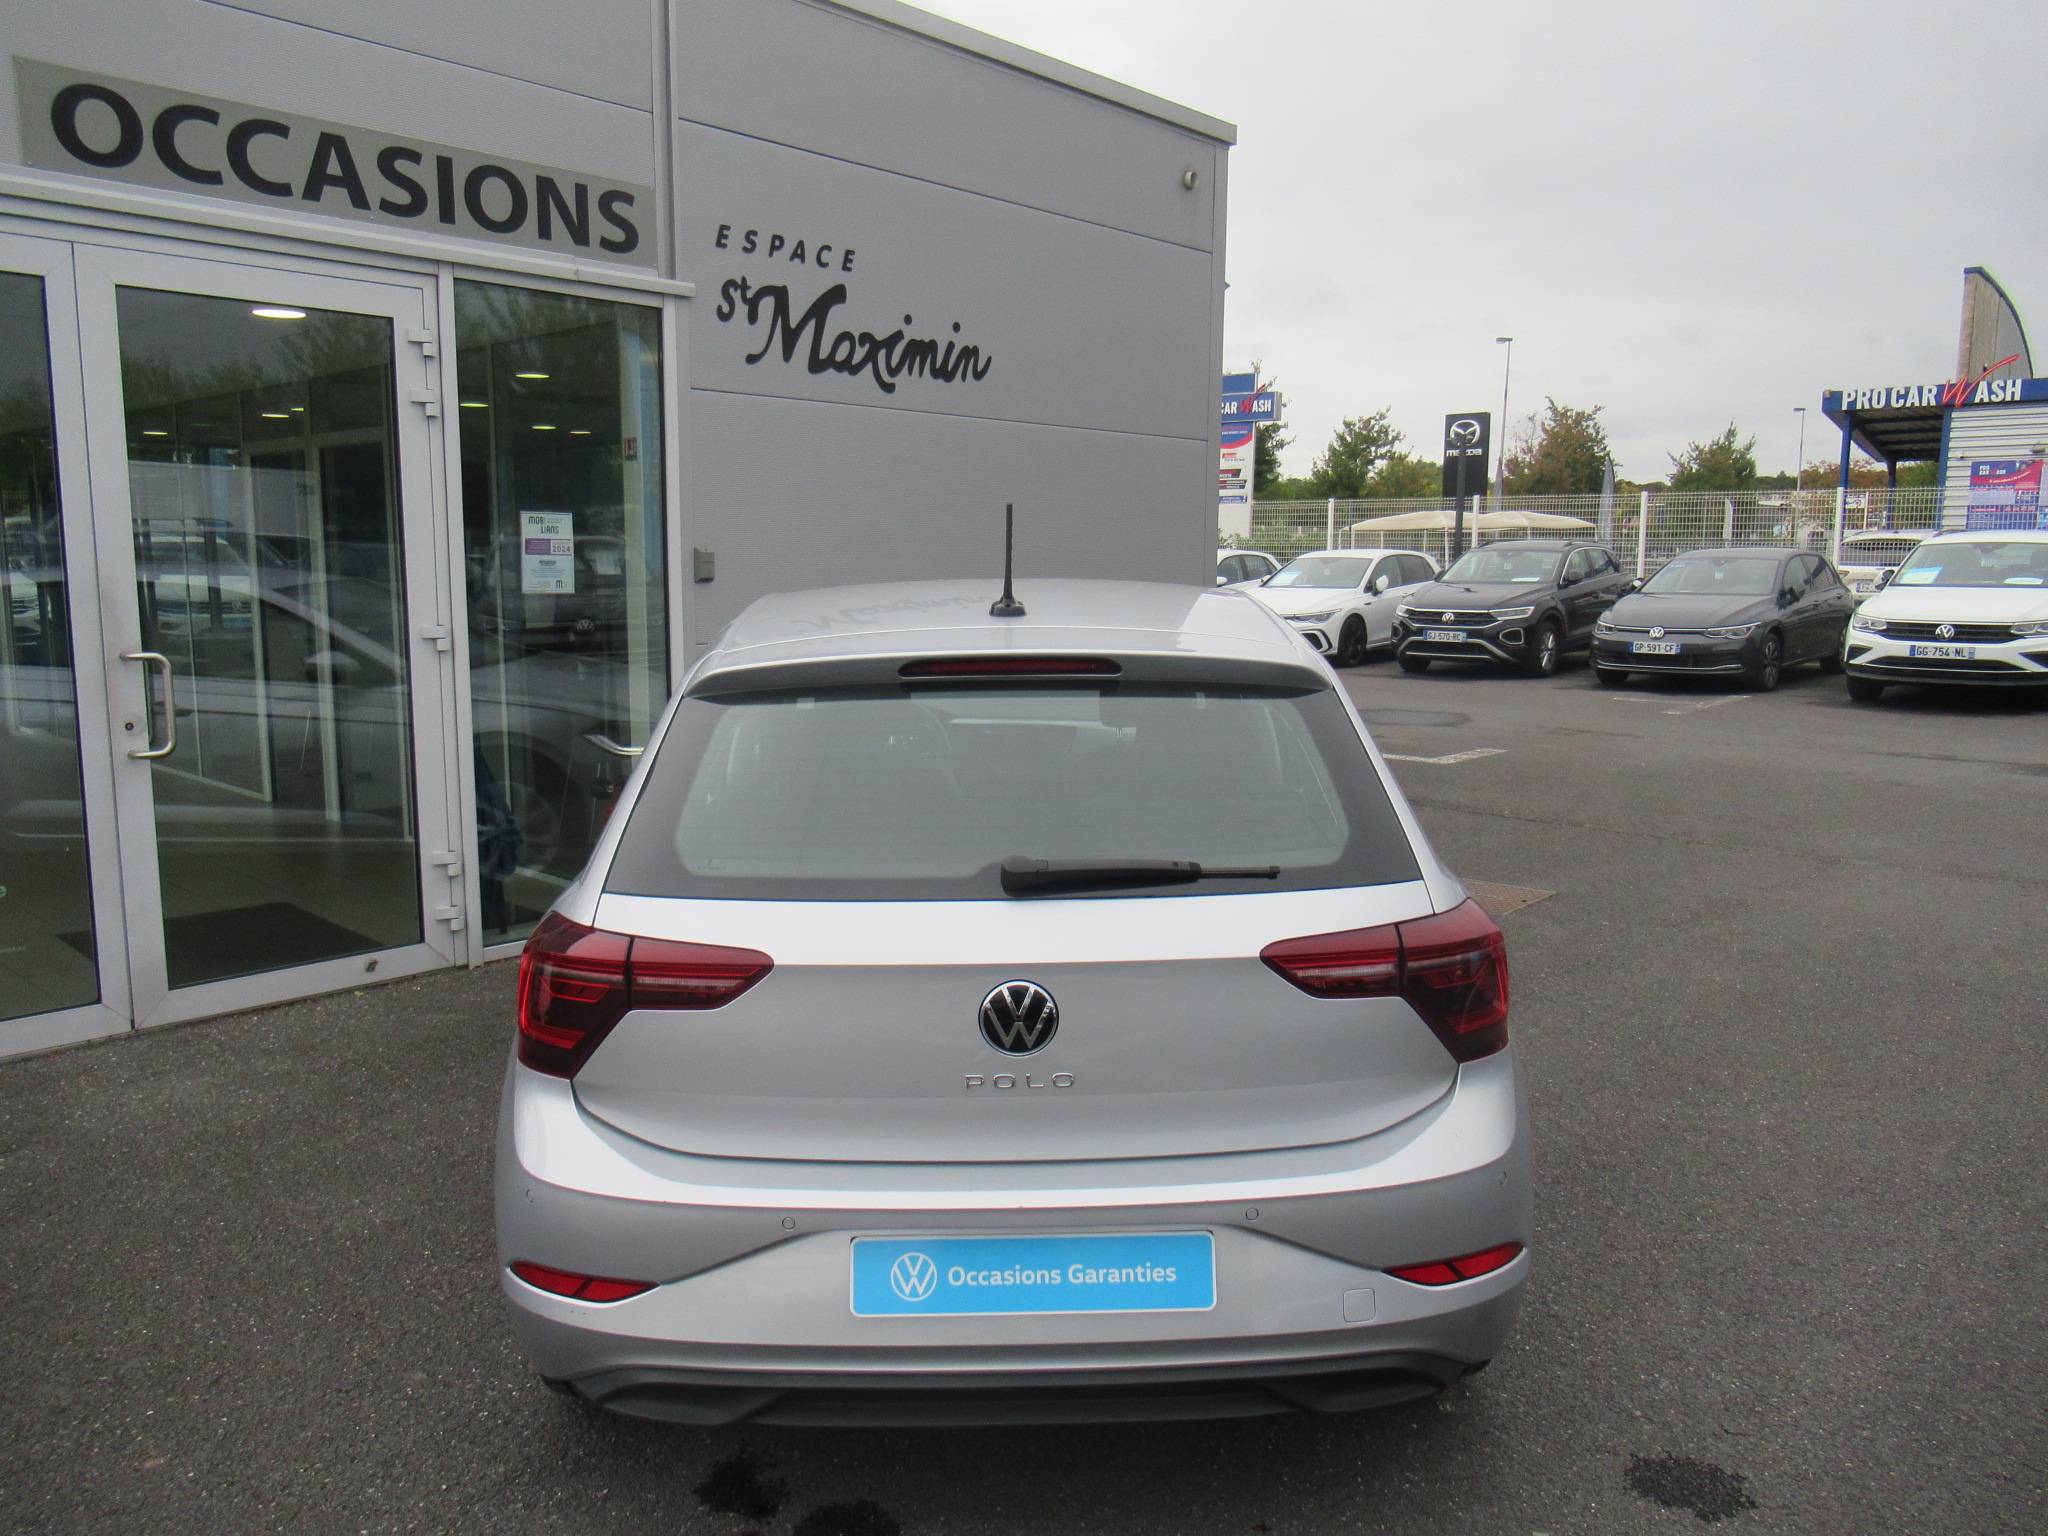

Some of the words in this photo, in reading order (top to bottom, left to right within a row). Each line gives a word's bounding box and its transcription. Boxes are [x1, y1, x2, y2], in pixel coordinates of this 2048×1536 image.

[50, 83, 640, 254] OCCASIONS
[715, 224, 856, 272] ESPACE
[745, 283, 992, 394] Maximin
[1841, 384, 1886, 411] PRO
[1890, 384, 1938, 408] CAR
[1942, 354, 2022, 409] WASH
[1916, 646, 1967, 658] GG-754-NL
[965, 1072, 1074, 1089] POLO
[947, 1265, 1062, 1286] Occasions
[1067, 1263, 1177, 1284] Garanties
